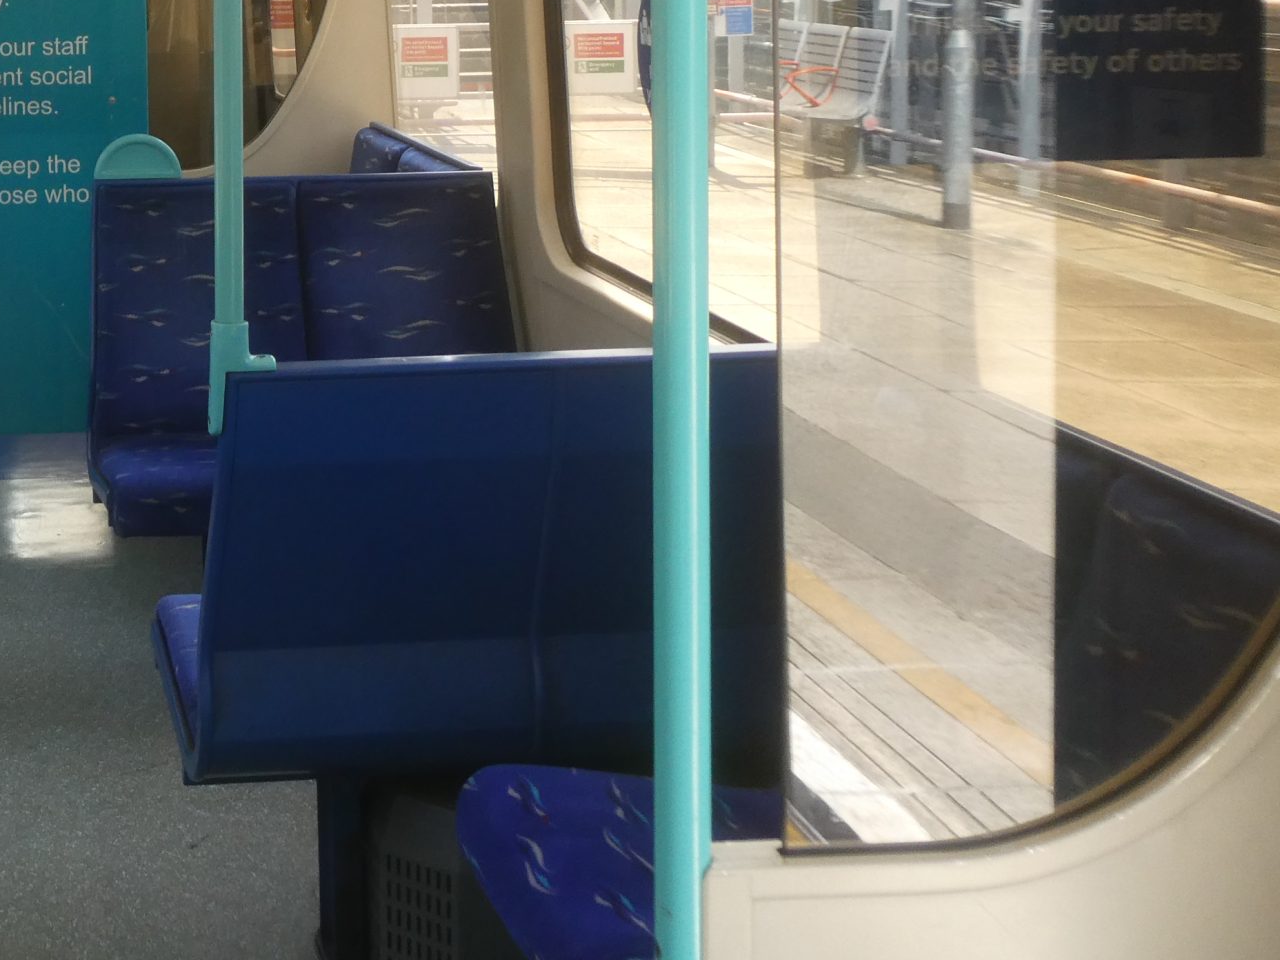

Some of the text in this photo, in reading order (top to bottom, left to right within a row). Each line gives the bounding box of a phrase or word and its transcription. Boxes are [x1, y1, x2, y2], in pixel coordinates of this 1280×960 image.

[1059, 12, 1124, 39] your
[1132, 10, 1223, 38] safety
[0, 42, 35, 56] our
[43, 36, 88, 55] staff
[1106, 47, 1139, 74] of
[1147, 47, 1243, 74] others
[31, 66, 91, 85] social
[47, 155, 80, 173] the
[45, 184, 89, 203] who
